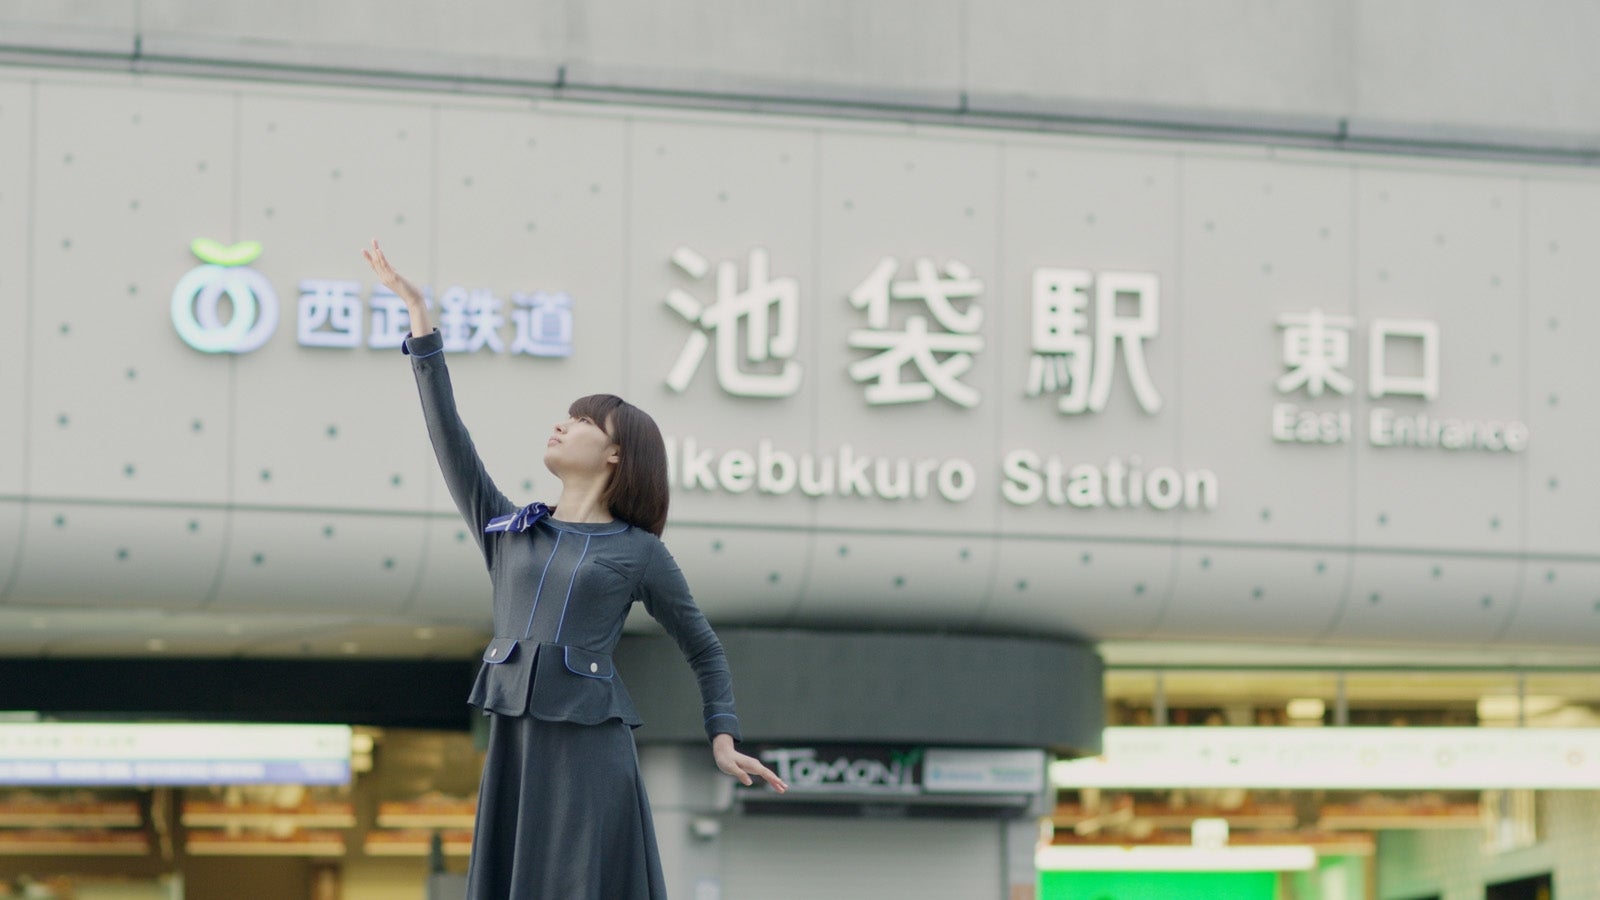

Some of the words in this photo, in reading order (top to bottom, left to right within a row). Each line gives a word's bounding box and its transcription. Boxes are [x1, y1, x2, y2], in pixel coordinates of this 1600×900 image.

[665, 246, 1163, 414] 池袋駅
[1274, 308, 1439, 400] 東口
[1272, 402, 1350, 443] East
[1369, 407, 1529, 451] Entrance
[667, 436, 977, 501] Ikebukuro
[1001, 448, 1219, 510] Station
